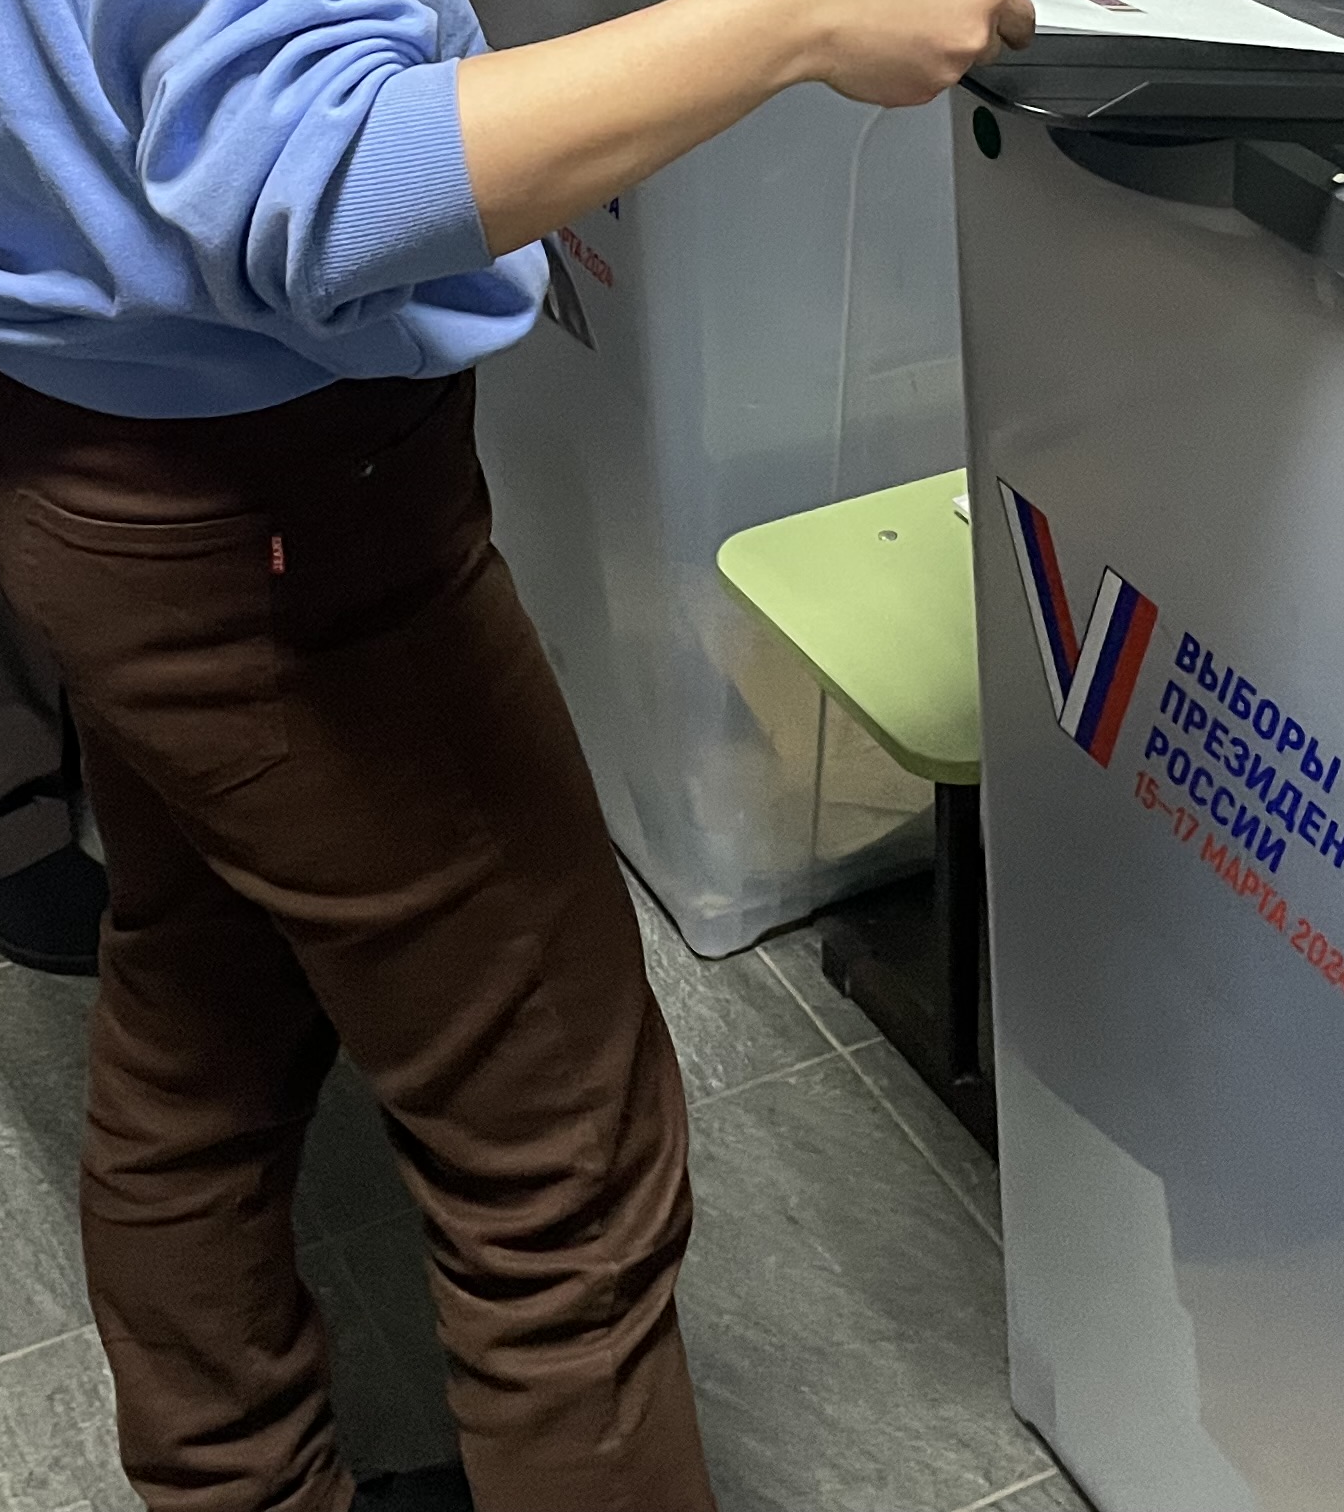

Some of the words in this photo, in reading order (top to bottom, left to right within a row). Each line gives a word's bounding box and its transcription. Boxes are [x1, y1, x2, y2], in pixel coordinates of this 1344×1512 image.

[1173, 631, 1343, 794] ВЫБОРЫ
[1144, 724, 1288, 874] РОССИИ
[1199, 831, 1289, 933] МАРТА
